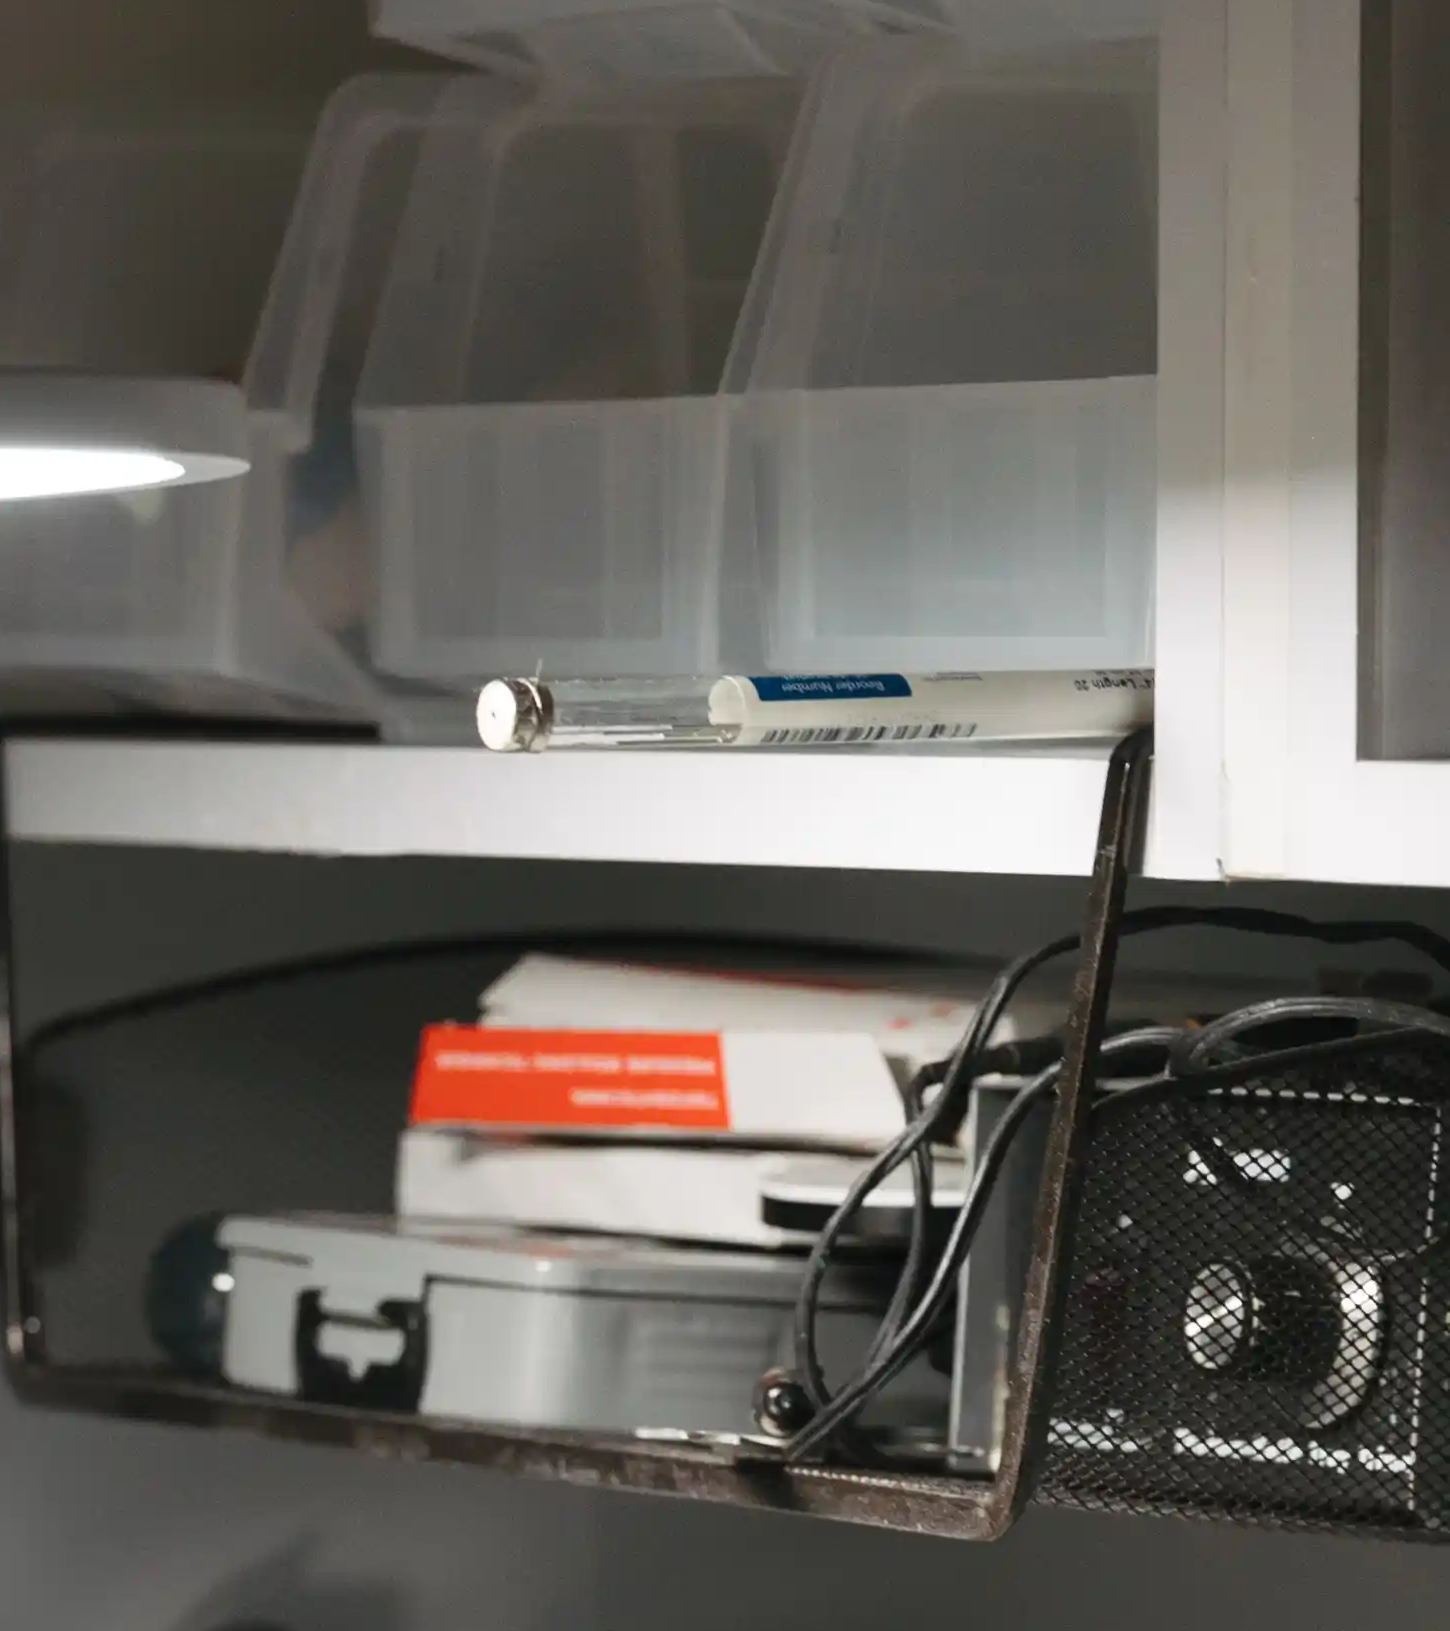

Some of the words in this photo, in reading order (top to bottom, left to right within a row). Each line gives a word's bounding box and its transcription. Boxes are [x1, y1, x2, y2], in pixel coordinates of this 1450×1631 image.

[781, 681, 833, 694] Number
[836, 679, 885, 692] Reorder
[1092, 676, 1138, 690] Length
